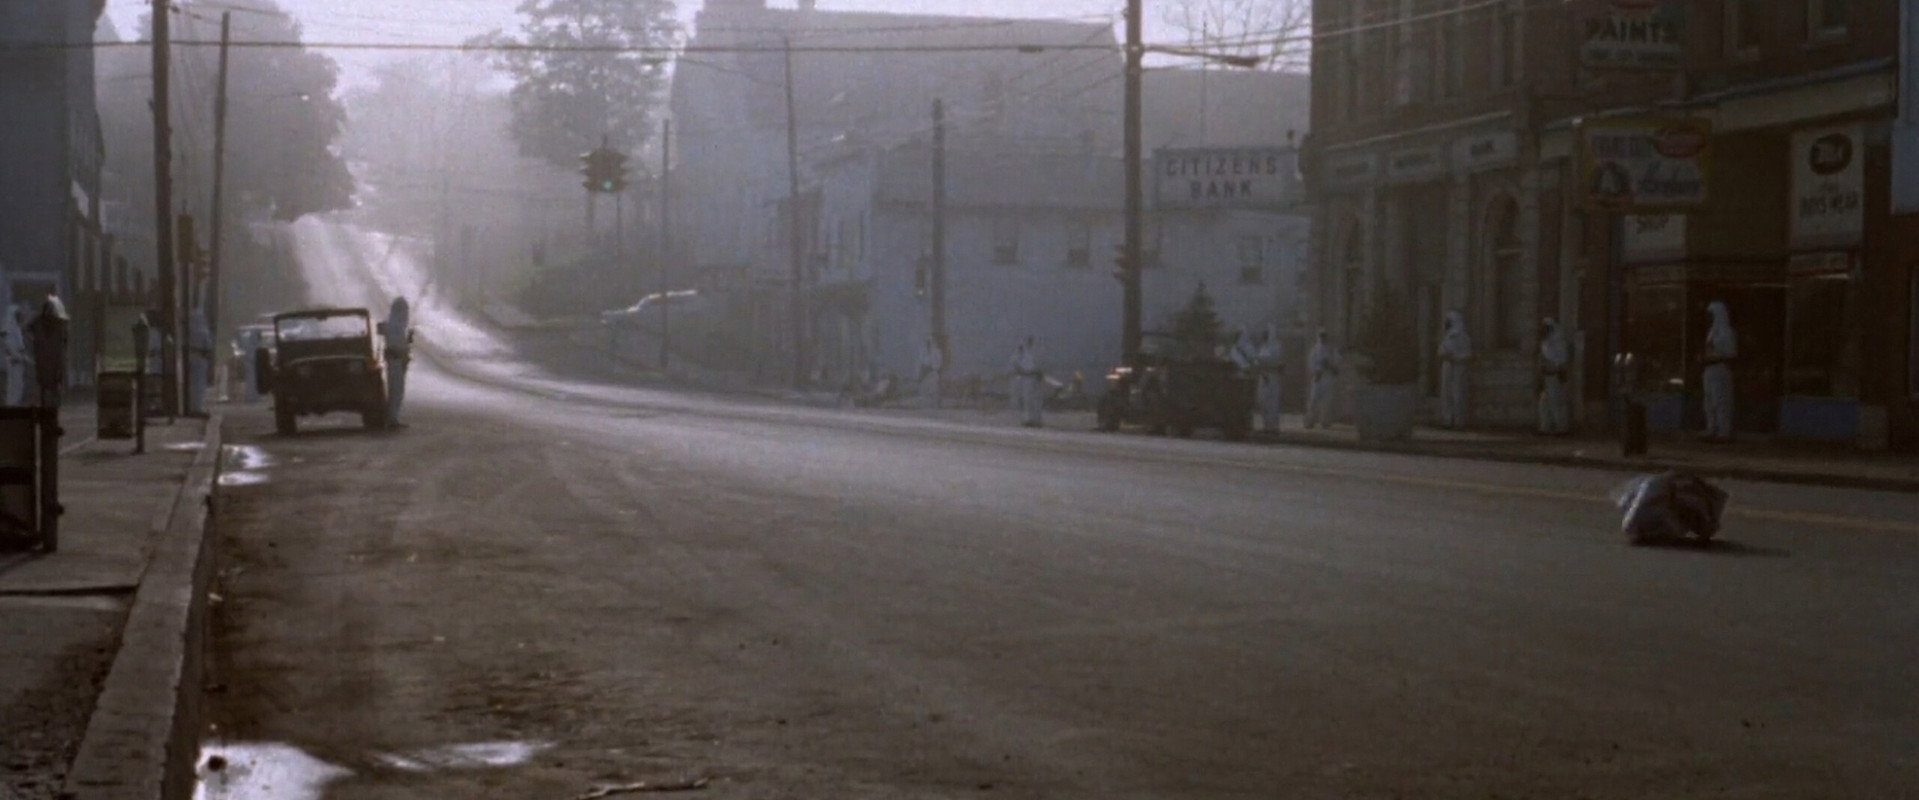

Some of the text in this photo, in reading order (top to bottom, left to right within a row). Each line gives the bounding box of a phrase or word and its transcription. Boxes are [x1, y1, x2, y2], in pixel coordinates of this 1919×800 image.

[1585, 18, 1679, 43] PAINTS
[1166, 156, 1284, 177] CITIZENS
[1191, 179, 1258, 200] BANK
